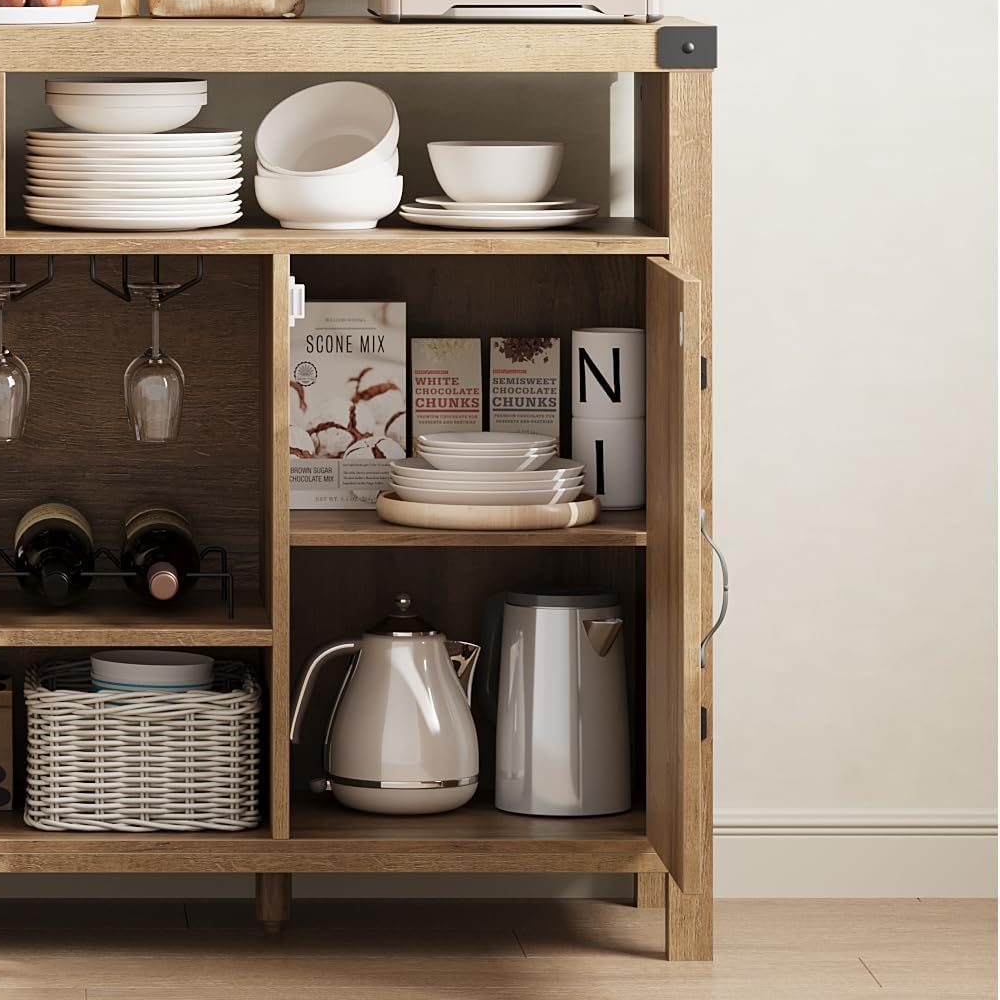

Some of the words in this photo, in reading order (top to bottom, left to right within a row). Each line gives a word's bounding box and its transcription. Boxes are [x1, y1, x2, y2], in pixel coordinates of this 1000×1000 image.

[306, 334, 353, 353] SCONE
[360, 334, 385, 353] MIX
[578, 347, 621, 402] N
[415, 377, 459, 386] WHITE
[492, 377, 557, 385] SEMISWEET
[415, 387, 480, 395] CHOCOLATE
[492, 386, 557, 395] CHOCOLATE
[415, 397, 480, 408] CHUNKS
[492, 396, 557, 408] CHUNKS
[290, 466, 311, 474] BROWN
[313, 466, 333, 474] SUGAR
[595, 440, 605, 495] I
[289, 475, 322, 483] CHOCOLATE
[323, 475, 334, 483] MIX
